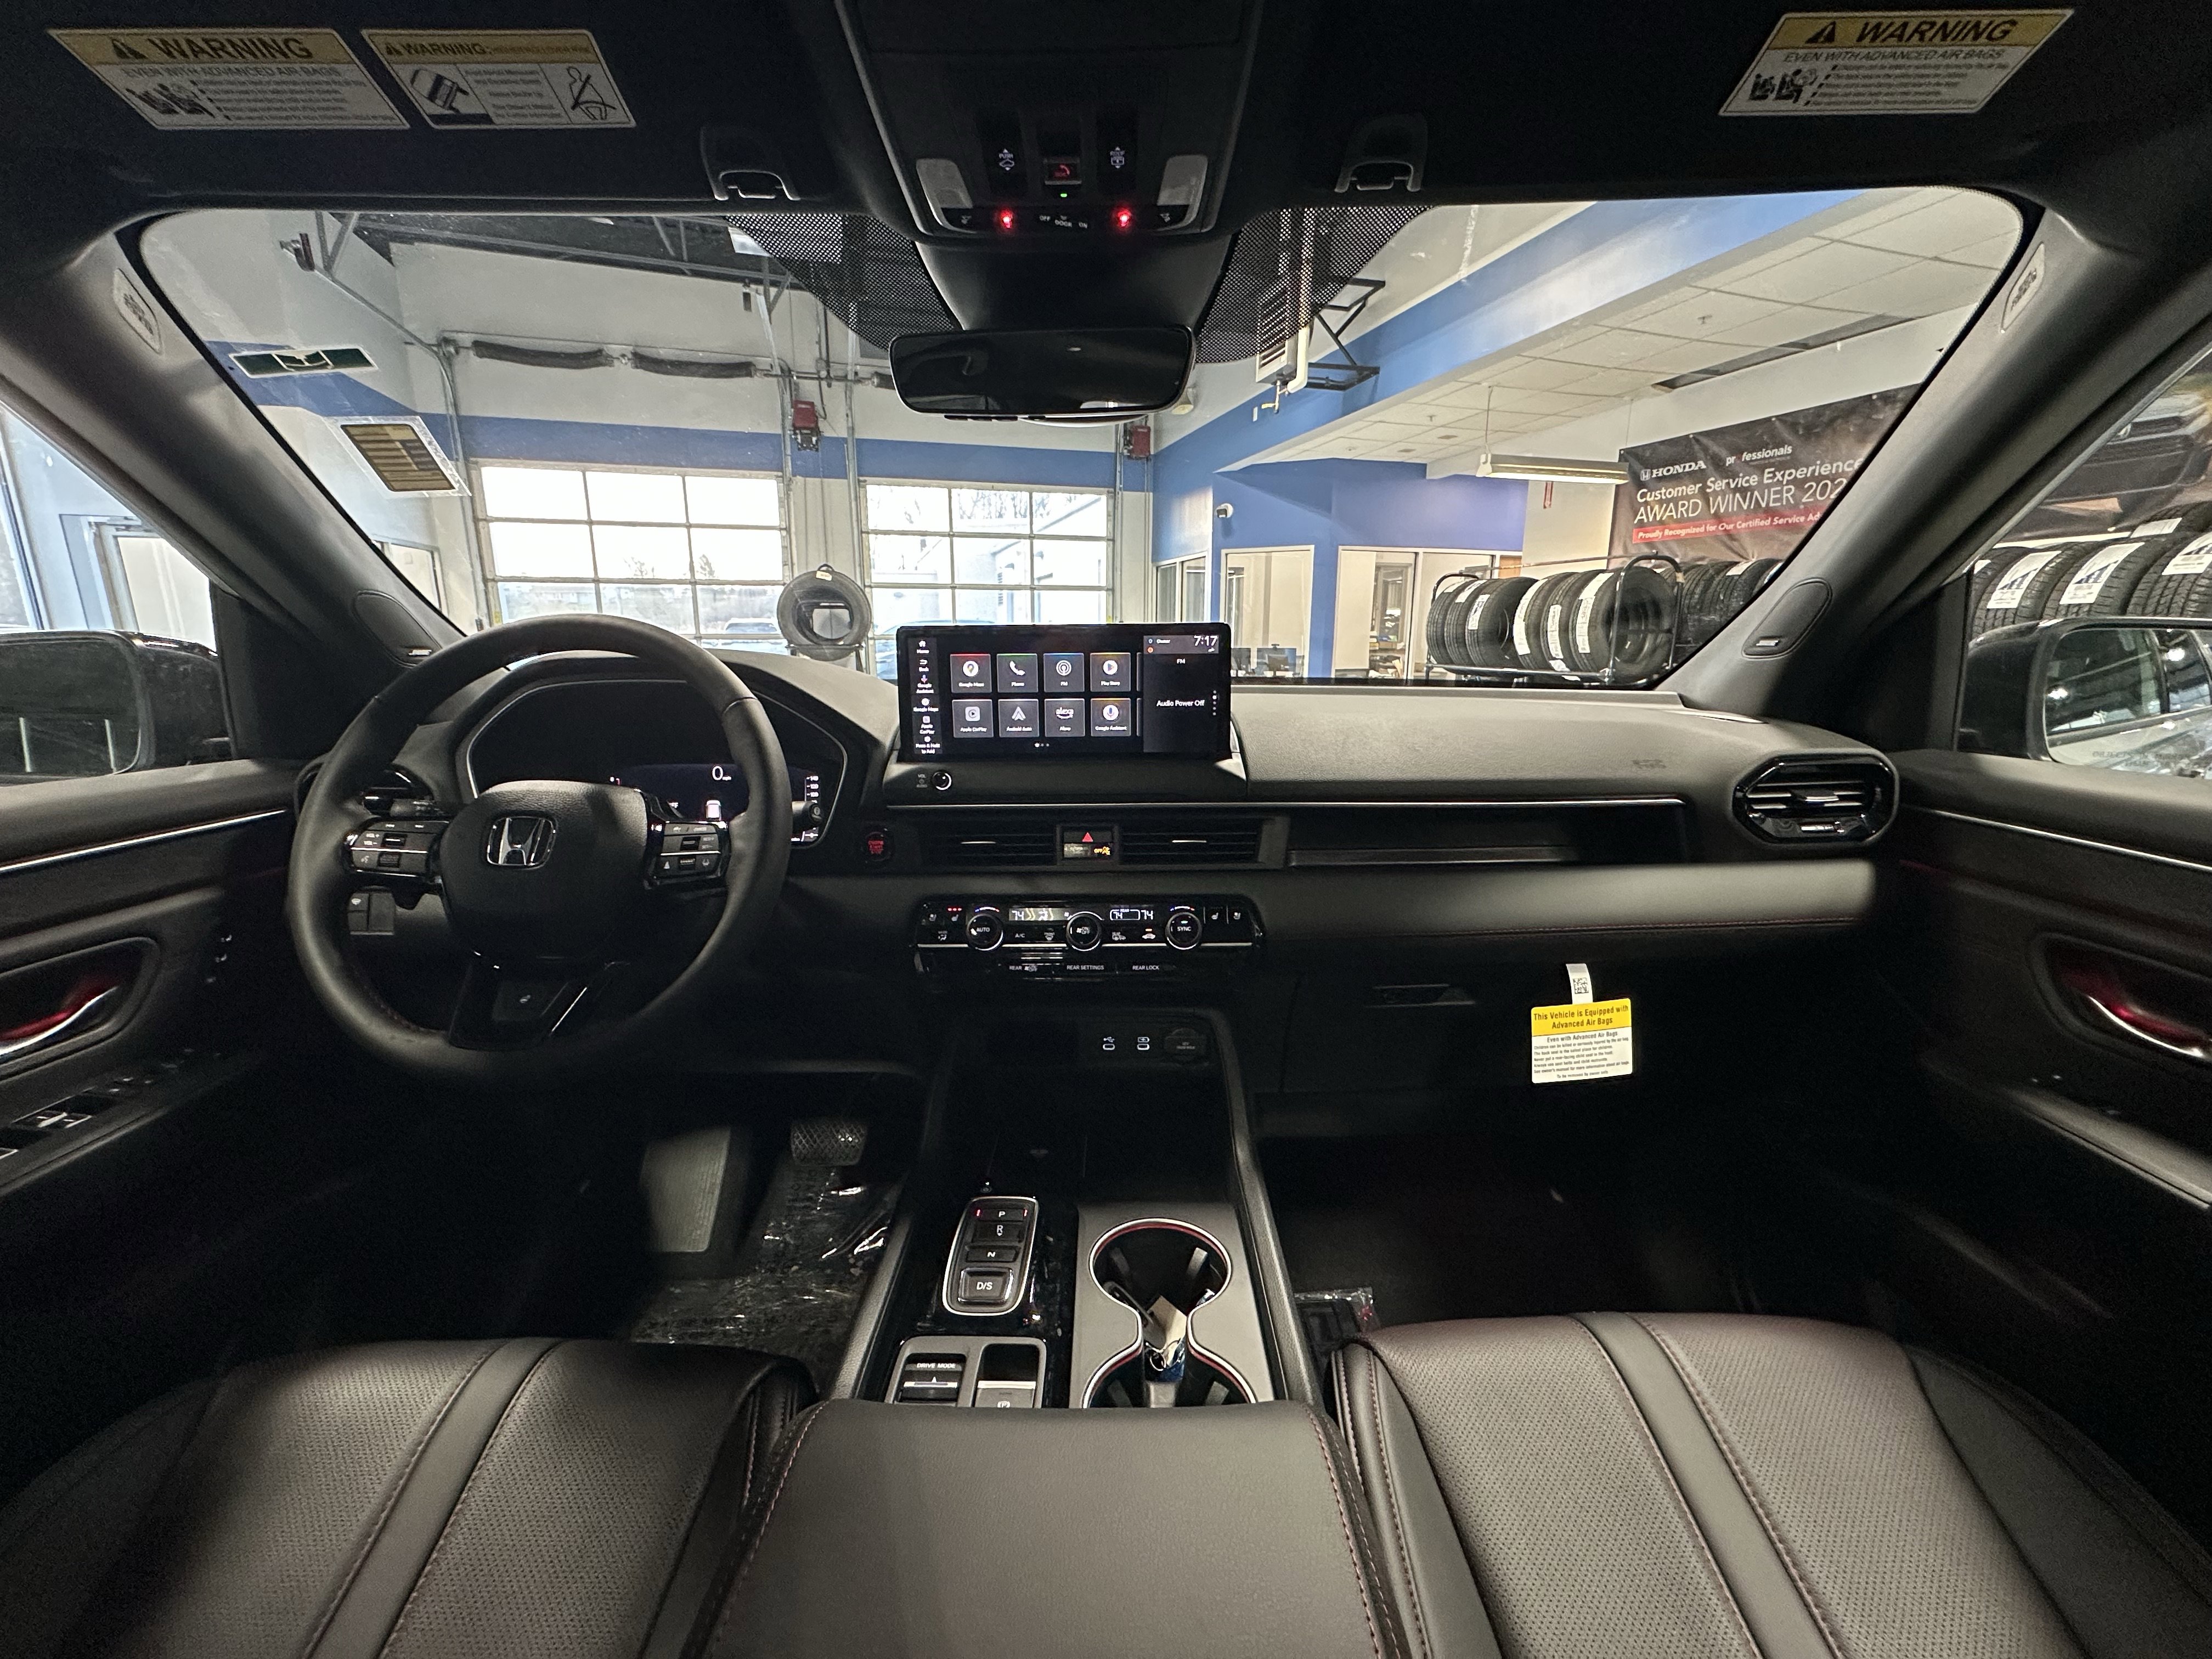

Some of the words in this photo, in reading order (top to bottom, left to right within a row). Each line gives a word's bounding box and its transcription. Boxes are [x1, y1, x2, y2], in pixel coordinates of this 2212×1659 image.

[1856, 19, 2018, 43] WARNING
[149, 38, 313, 59] WARNING
[1726, 444, 1792, 466] prfessionals
[1651, 461, 1707, 478] HONDA
[1637, 483, 1702, 503] Customer
[1706, 472, 1758, 493] Service
[1634, 499, 1701, 523] AWARD
[1709, 485, 1795, 514] WINNER
[1638, 530, 1663, 540] Proudly
[1664, 525, 1705, 537] Recognized
[1706, 523, 1717, 532] for
[1718, 522, 1734, 531] Our
[1736, 517, 1771, 529] Certified
[1773, 515, 1805, 525] Service
[1194, 635, 1218, 646] 7:17
[712, 766, 723, 780] 0
[1011, 910, 1024, 921] 74
[1113, 911, 1123, 919] 74
[1141, 910, 1154, 920] 74
[1550, 1011, 1575, 1019] Vehicle
[1585, 1007, 1614, 1017] Equipped
[1552, 1020, 1584, 1029] Advanced
[1598, 1017, 1613, 1026] Bags
[976, 1281, 993, 1291] D/S
